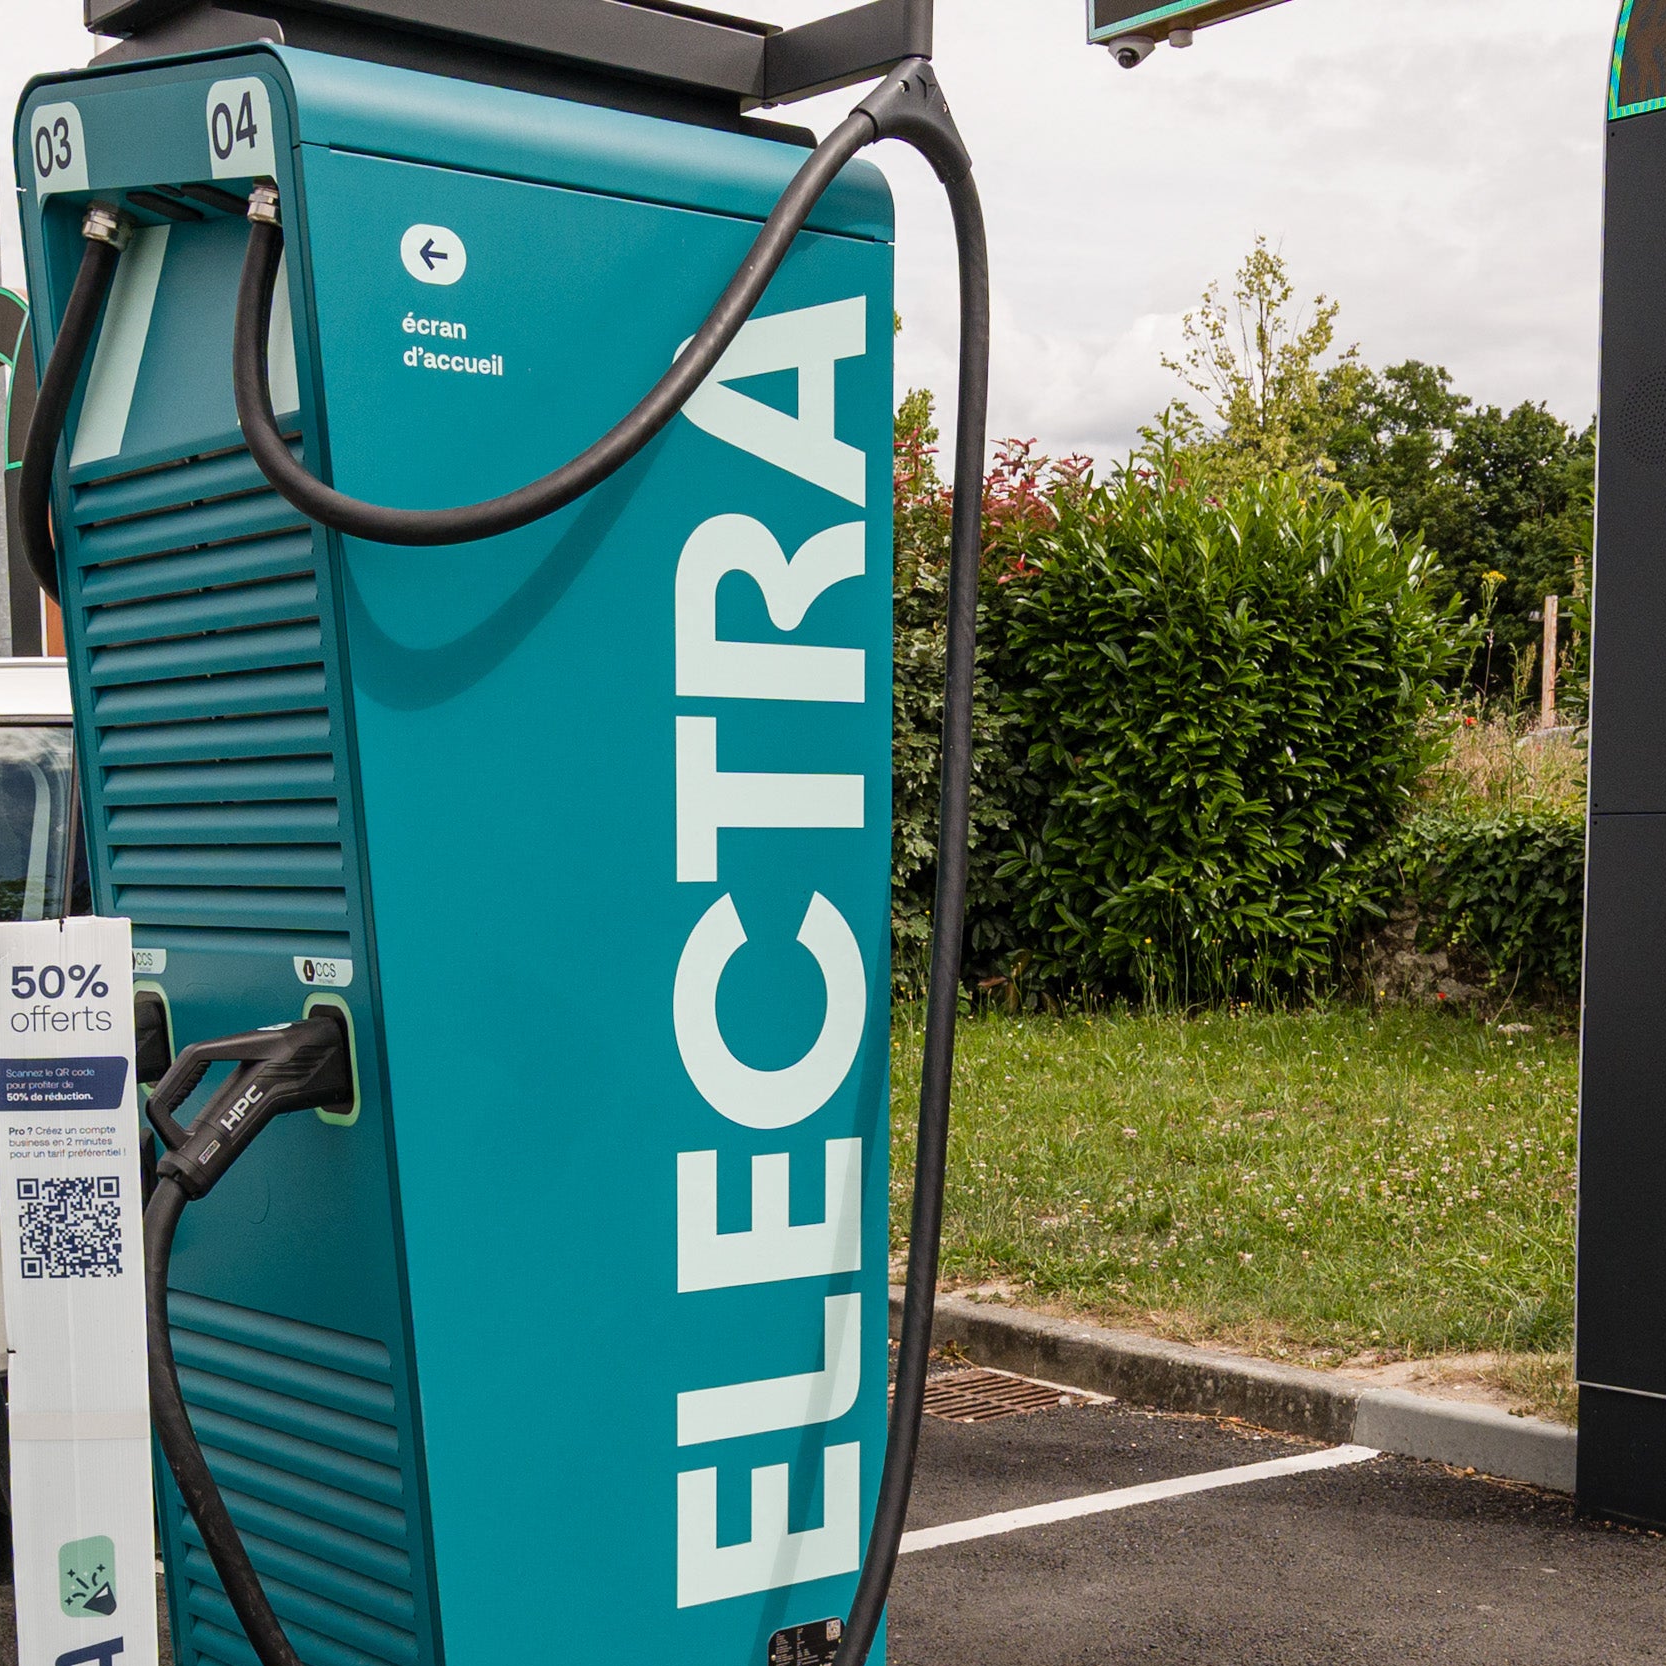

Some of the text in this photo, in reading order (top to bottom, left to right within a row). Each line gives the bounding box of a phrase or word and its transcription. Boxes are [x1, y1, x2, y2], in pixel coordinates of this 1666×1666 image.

[211, 90, 258, 160] 04
[35, 116, 72, 178] 03
[402, 311, 466, 340] écran
[403, 346, 503, 376] d'accueil
[136, 952, 153, 966] CCS
[673, 296, 867, 1609] ELECTRA
[315, 962, 337, 978] CCS
[11, 964, 109, 999] 50%
[10, 1005, 112, 1033] offerts
[5, 1067, 95, 1078] Scannez le QR code
[6, 1082, 26, 1091] pour
[61, 1080, 74, 1089] de
[6, 1091, 94, 1102] 50% de réduction.
[220, 1084, 264, 1131] HPC
[8, 1127, 25, 1136] Pro
[35, 1126, 62, 1135] Créez
[64, 1127, 77, 1135] un
[79, 1126, 116, 1136] compte
[8, 1138, 50, 1147] business
[66, 1137, 73, 1146] 2
[75, 1137, 112, 1146] minutes
[9, 1150, 31, 1159] pour
[33, 1150, 45, 1158] un
